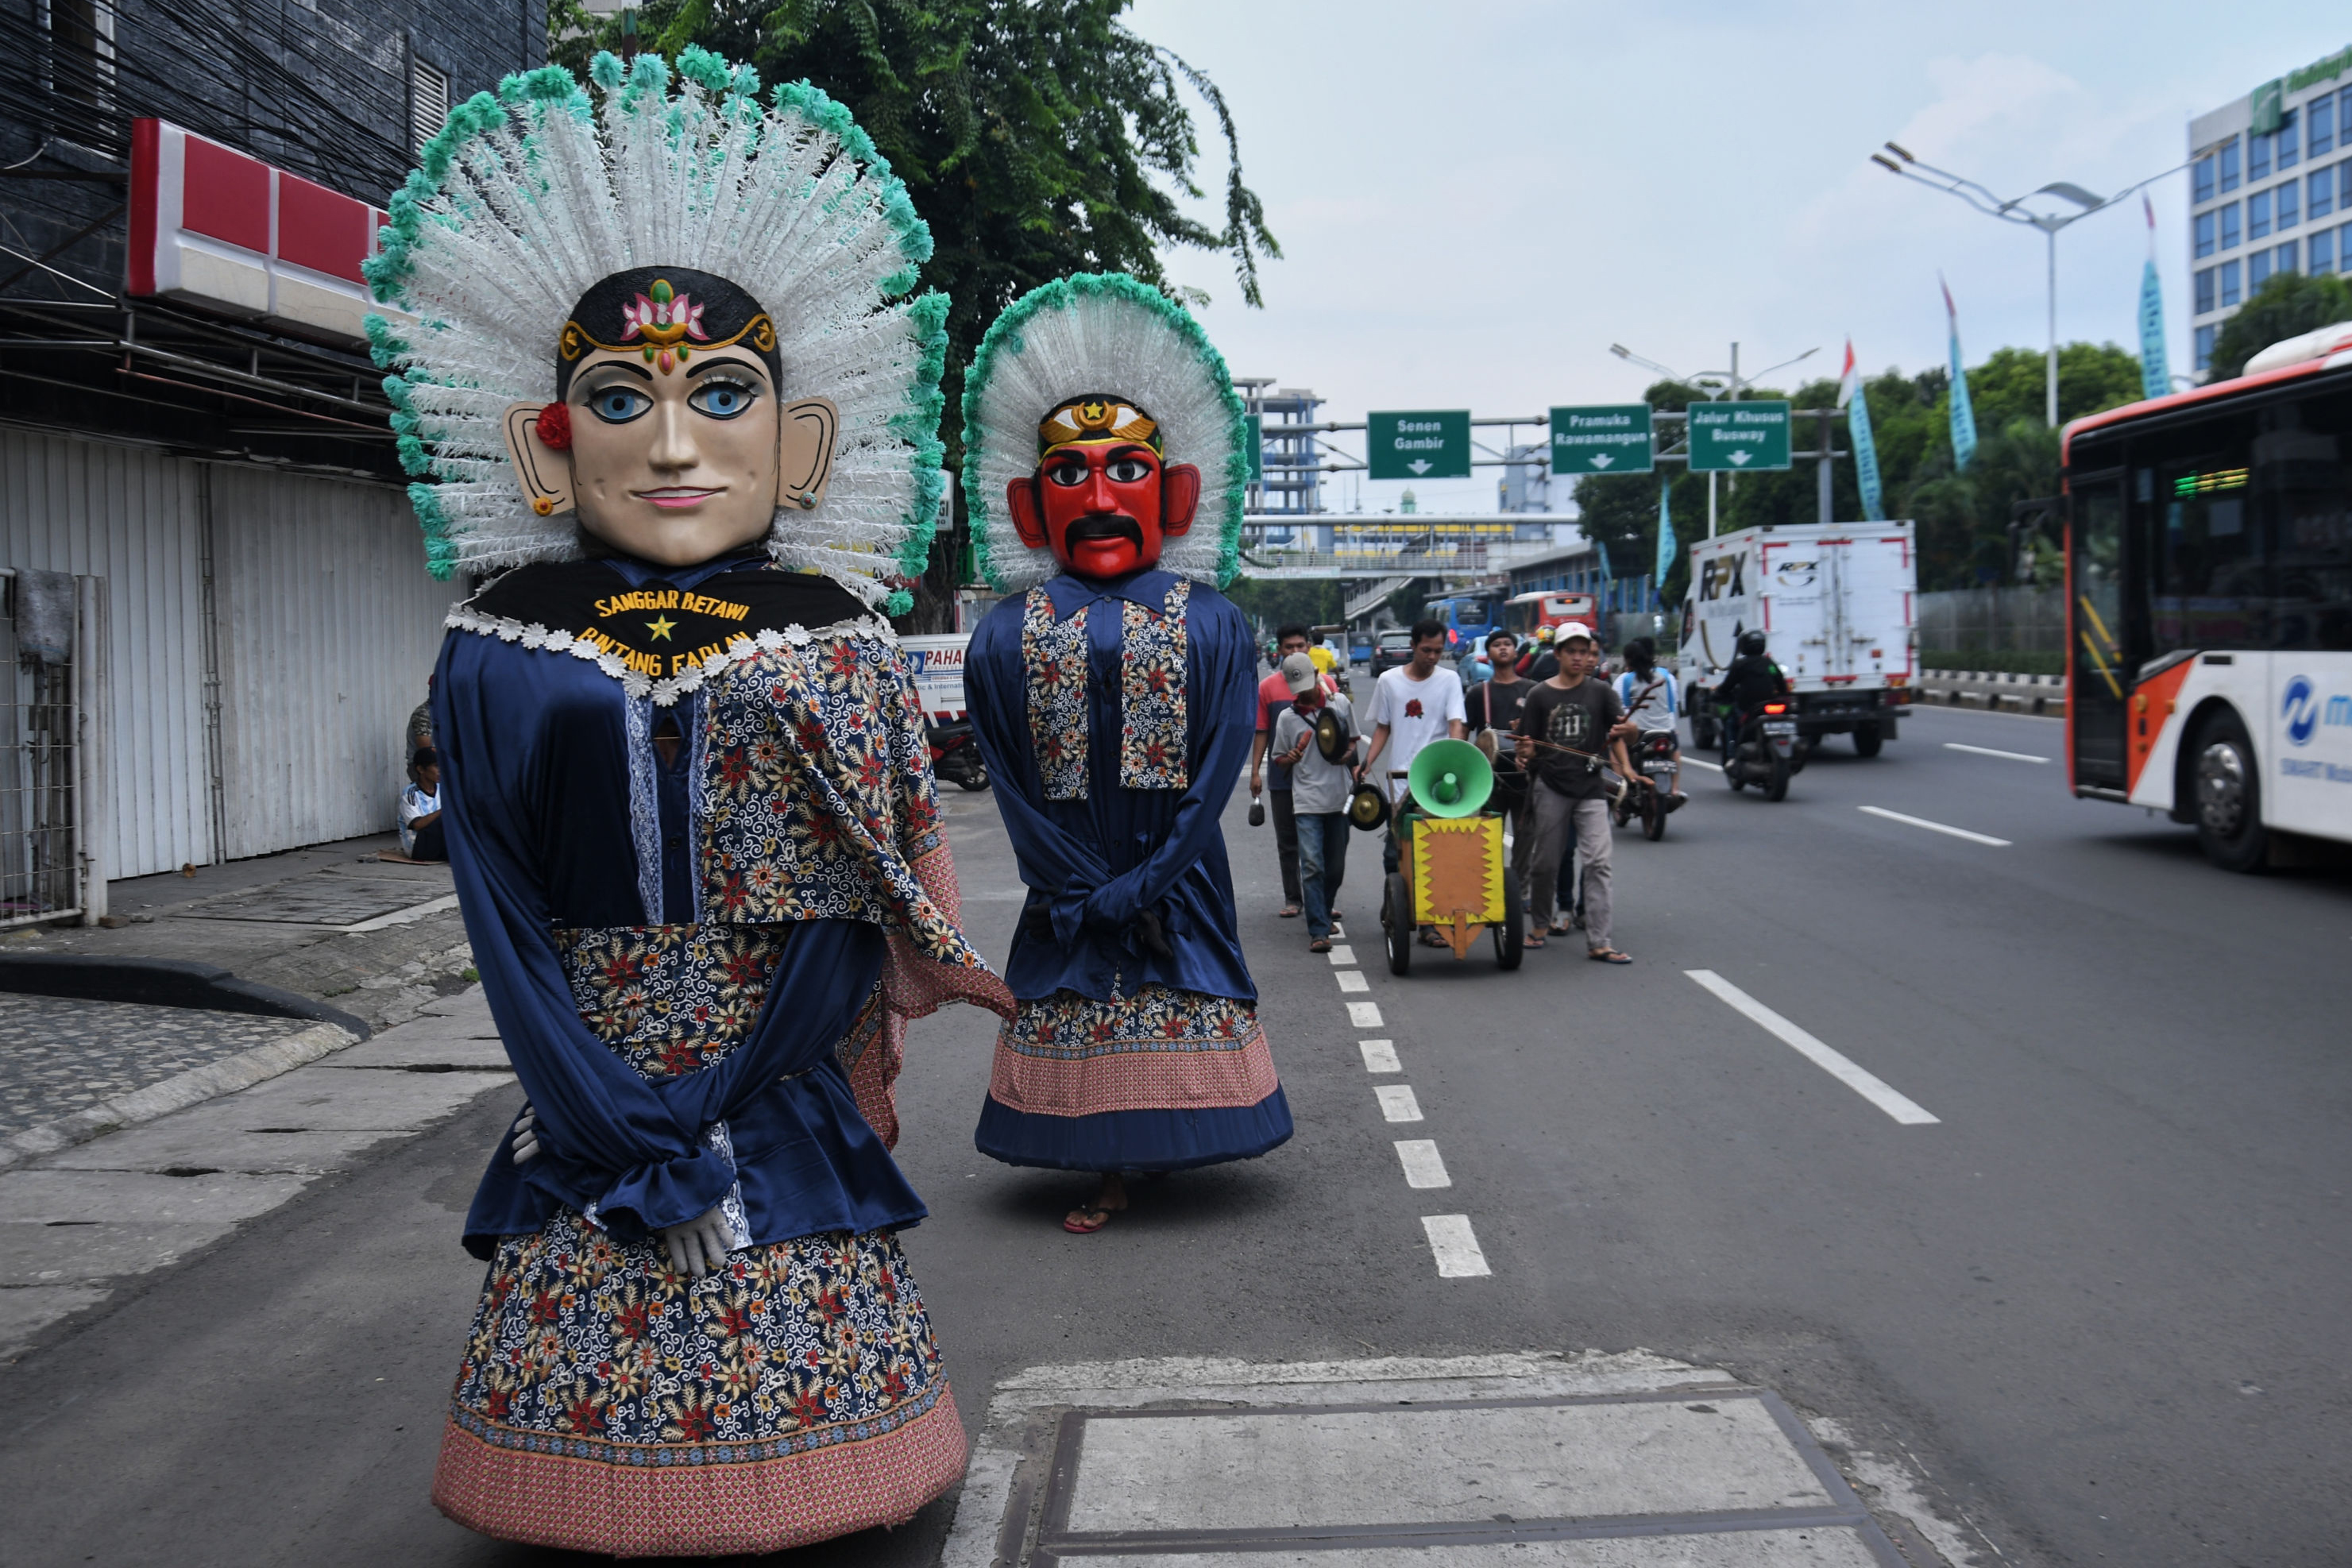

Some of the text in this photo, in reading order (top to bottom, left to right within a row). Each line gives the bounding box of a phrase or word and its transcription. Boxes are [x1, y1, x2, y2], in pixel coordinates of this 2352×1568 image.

[1570, 413, 1632, 427] Pramuka
[1694, 410, 1785, 424] Jalur Khusus
[1397, 419, 1442, 432] Senen
[1394, 437, 1444, 449] Gambir
[1555, 432, 1647, 446] Rawamangun
[1712, 428, 1766, 444] Busway
[1778, 561, 1819, 572] RPX
[1699, 550, 1748, 602] RPX
[594, 590, 751, 621] SANGGAR BETAWI
